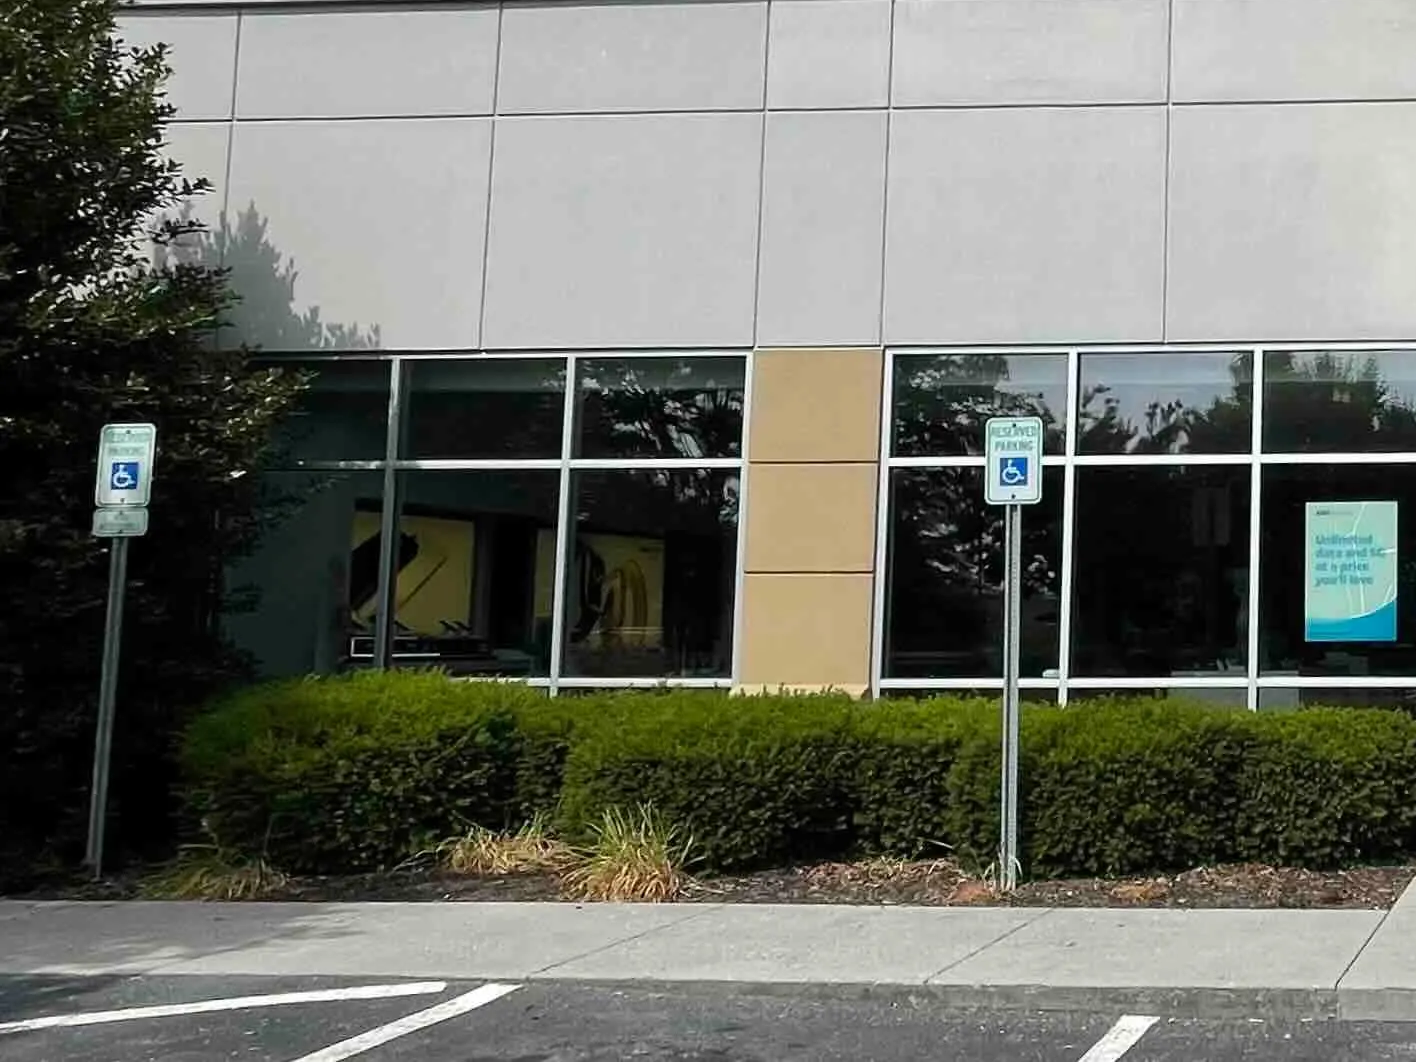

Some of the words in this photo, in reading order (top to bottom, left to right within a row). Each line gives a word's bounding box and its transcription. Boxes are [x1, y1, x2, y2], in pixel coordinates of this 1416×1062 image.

[991, 426, 1037, 437] RESERVED
[995, 441, 1033, 451] PARKING
[1316, 534, 1373, 545] Unlimited
[1345, 547, 1367, 558] and
[1316, 562, 1328, 571] at
[1340, 561, 1369, 575] price
[1349, 574, 1374, 585] love
